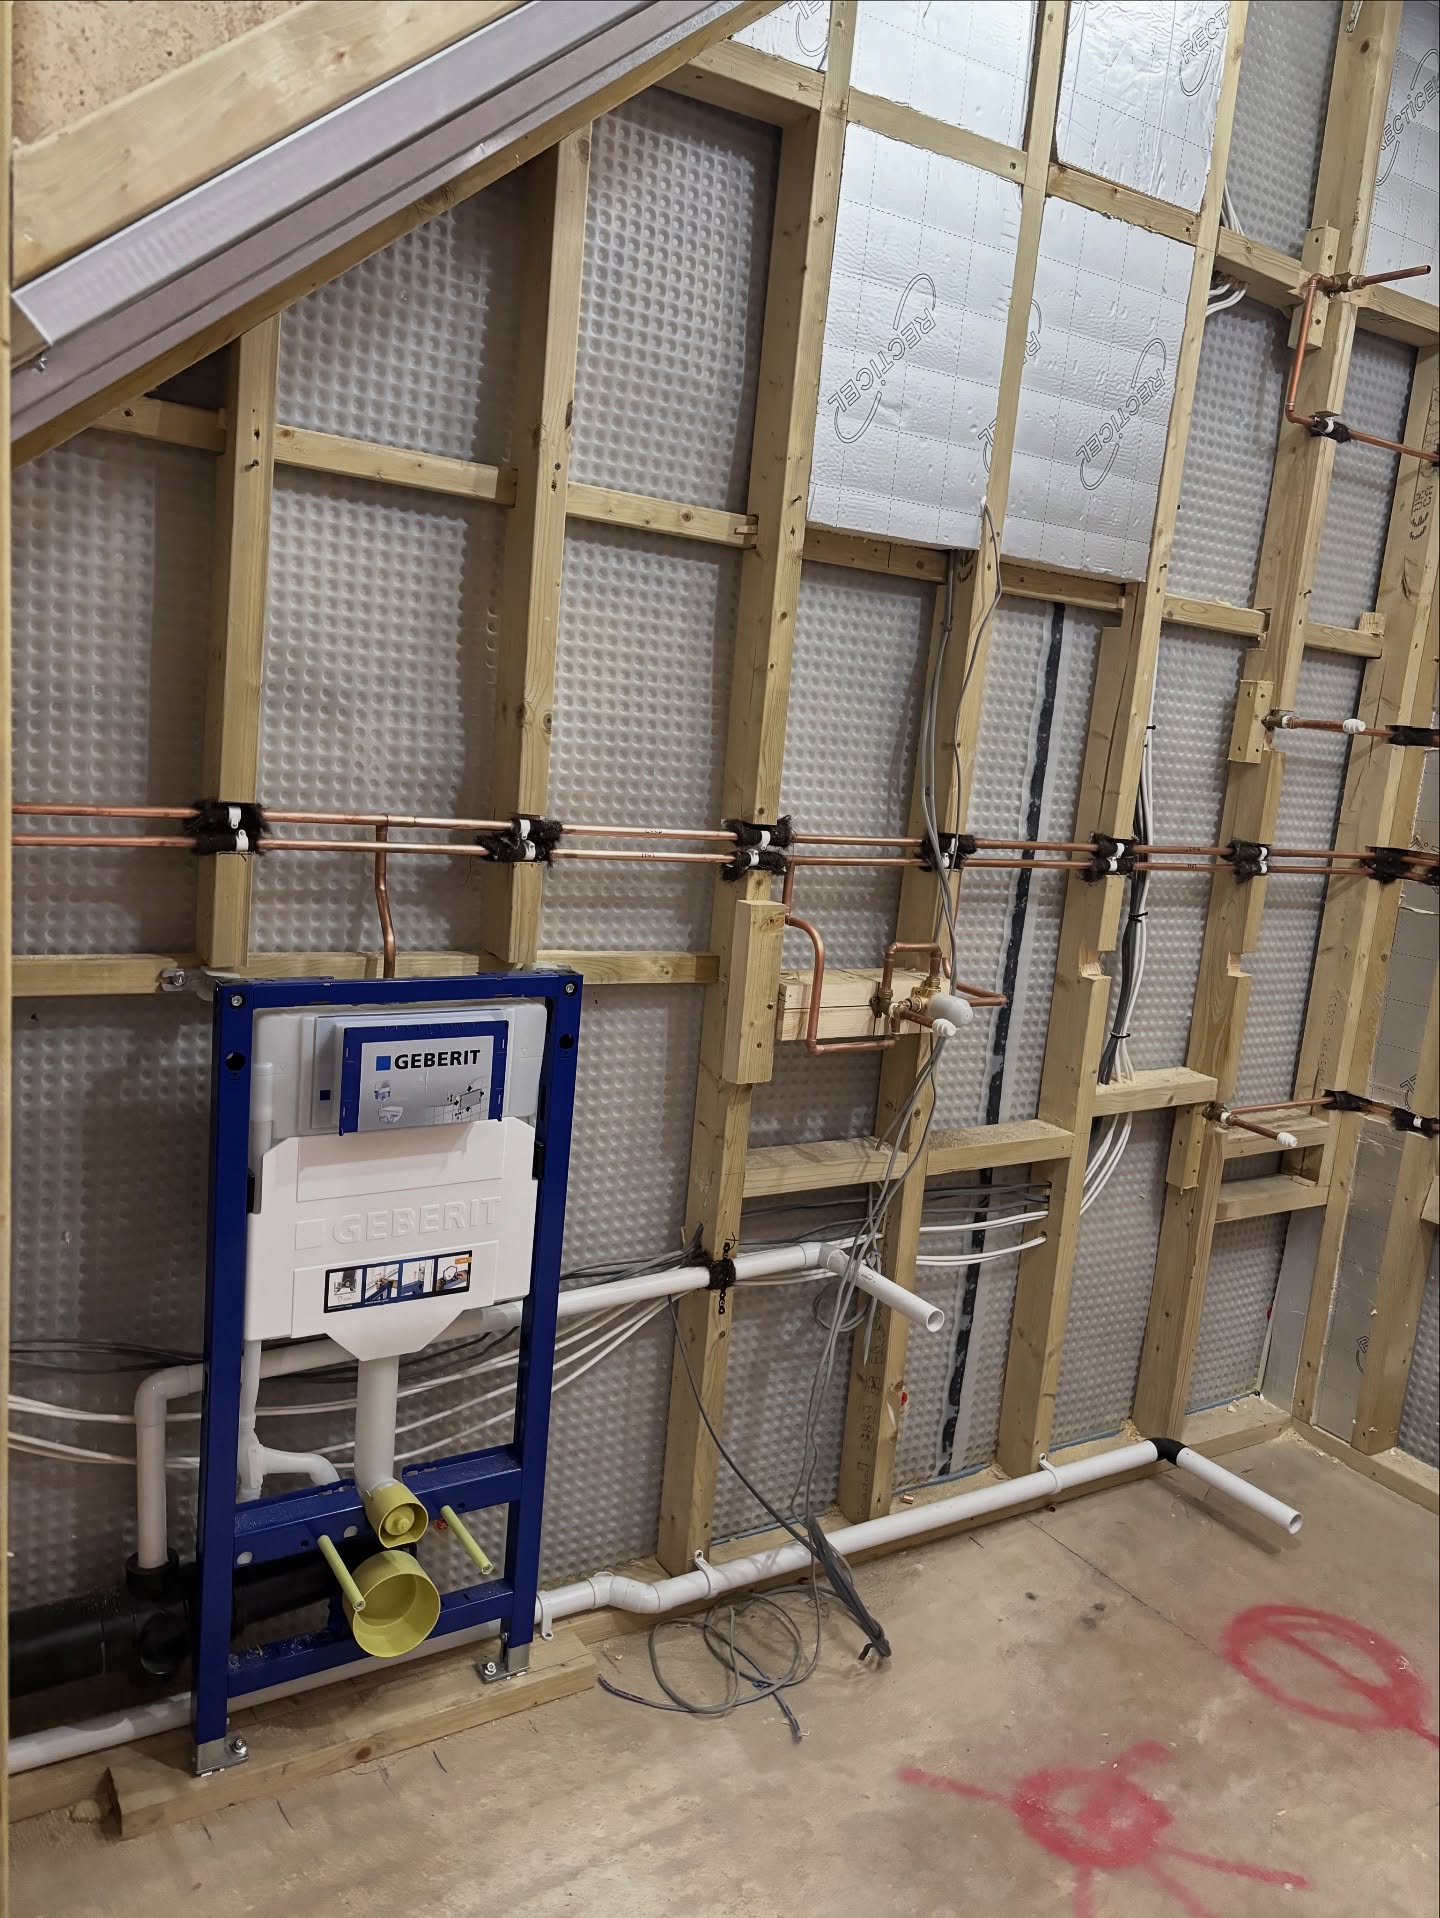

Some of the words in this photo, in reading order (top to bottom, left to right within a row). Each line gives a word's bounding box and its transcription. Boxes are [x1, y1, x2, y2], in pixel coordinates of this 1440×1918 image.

[1380, 75, 1438, 151] ECTICE
[828, 307, 936, 412] RECTICEL
[1076, 368, 1165, 463] RECTICEL
[394, 1049, 481, 1070] GEBERIT
[332, 1196, 502, 1245] GEBERIT
